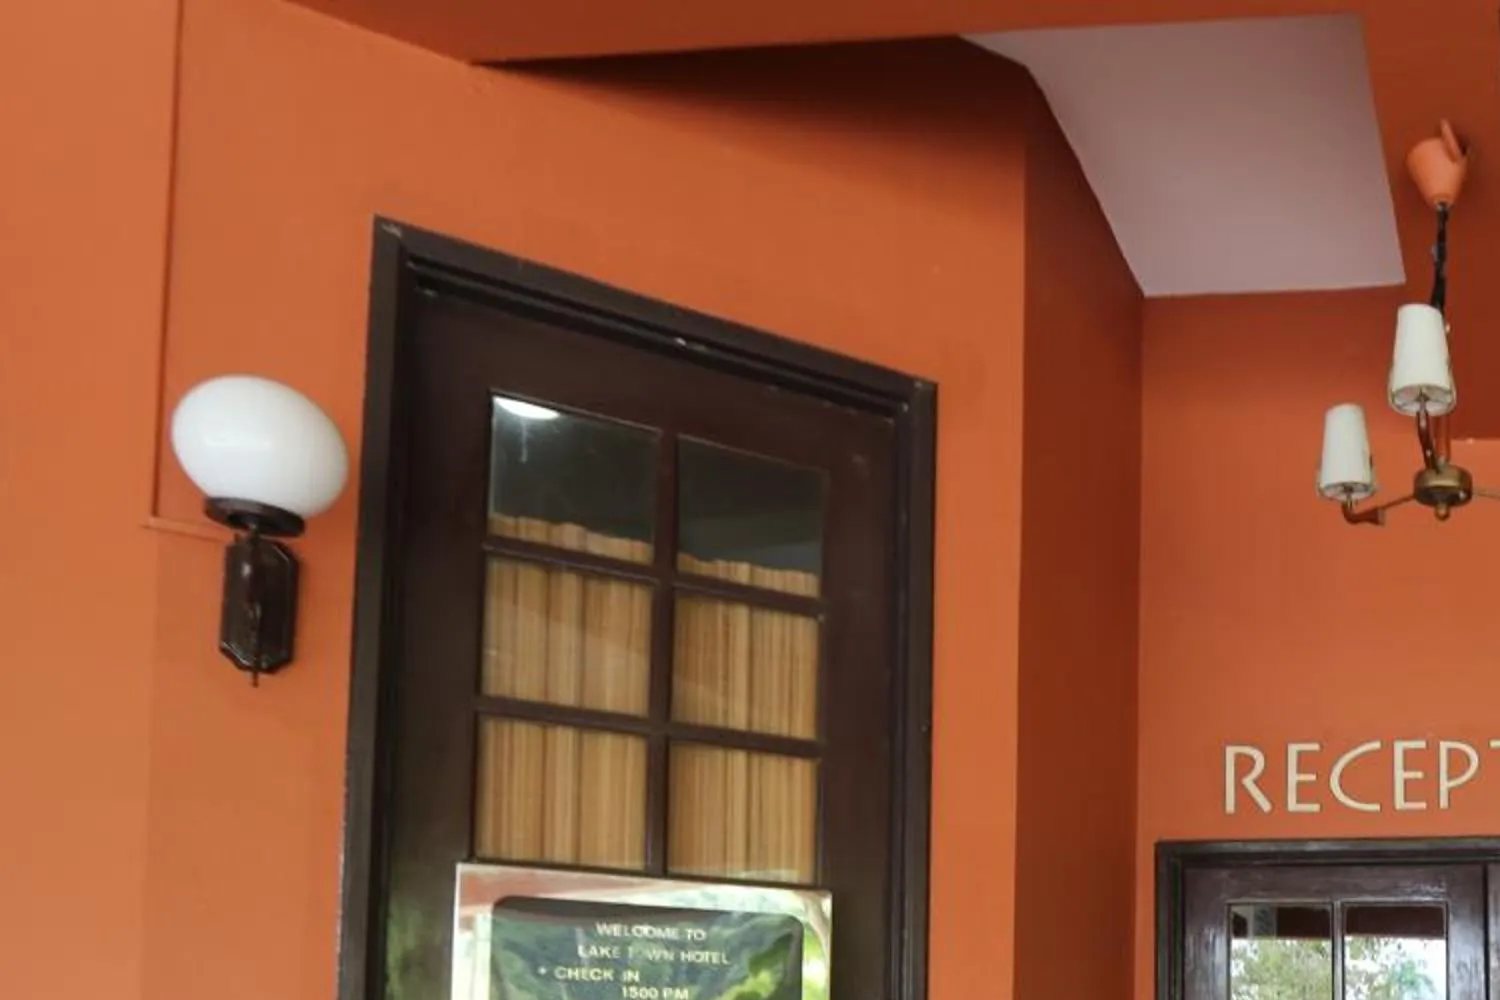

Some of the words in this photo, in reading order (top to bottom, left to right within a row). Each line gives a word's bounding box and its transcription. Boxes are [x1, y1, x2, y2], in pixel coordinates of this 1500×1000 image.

[596, 922, 680, 940] WELCOME
[686, 927, 707, 941] TO
[577, 945, 621, 959] LAKE
[628, 946, 674, 961] TWN
[680, 952, 731, 965] HOTEL
[554, 968, 614, 981] CHECK
[623, 970, 640, 982] IN
[663, 988, 689, 1000] PM
